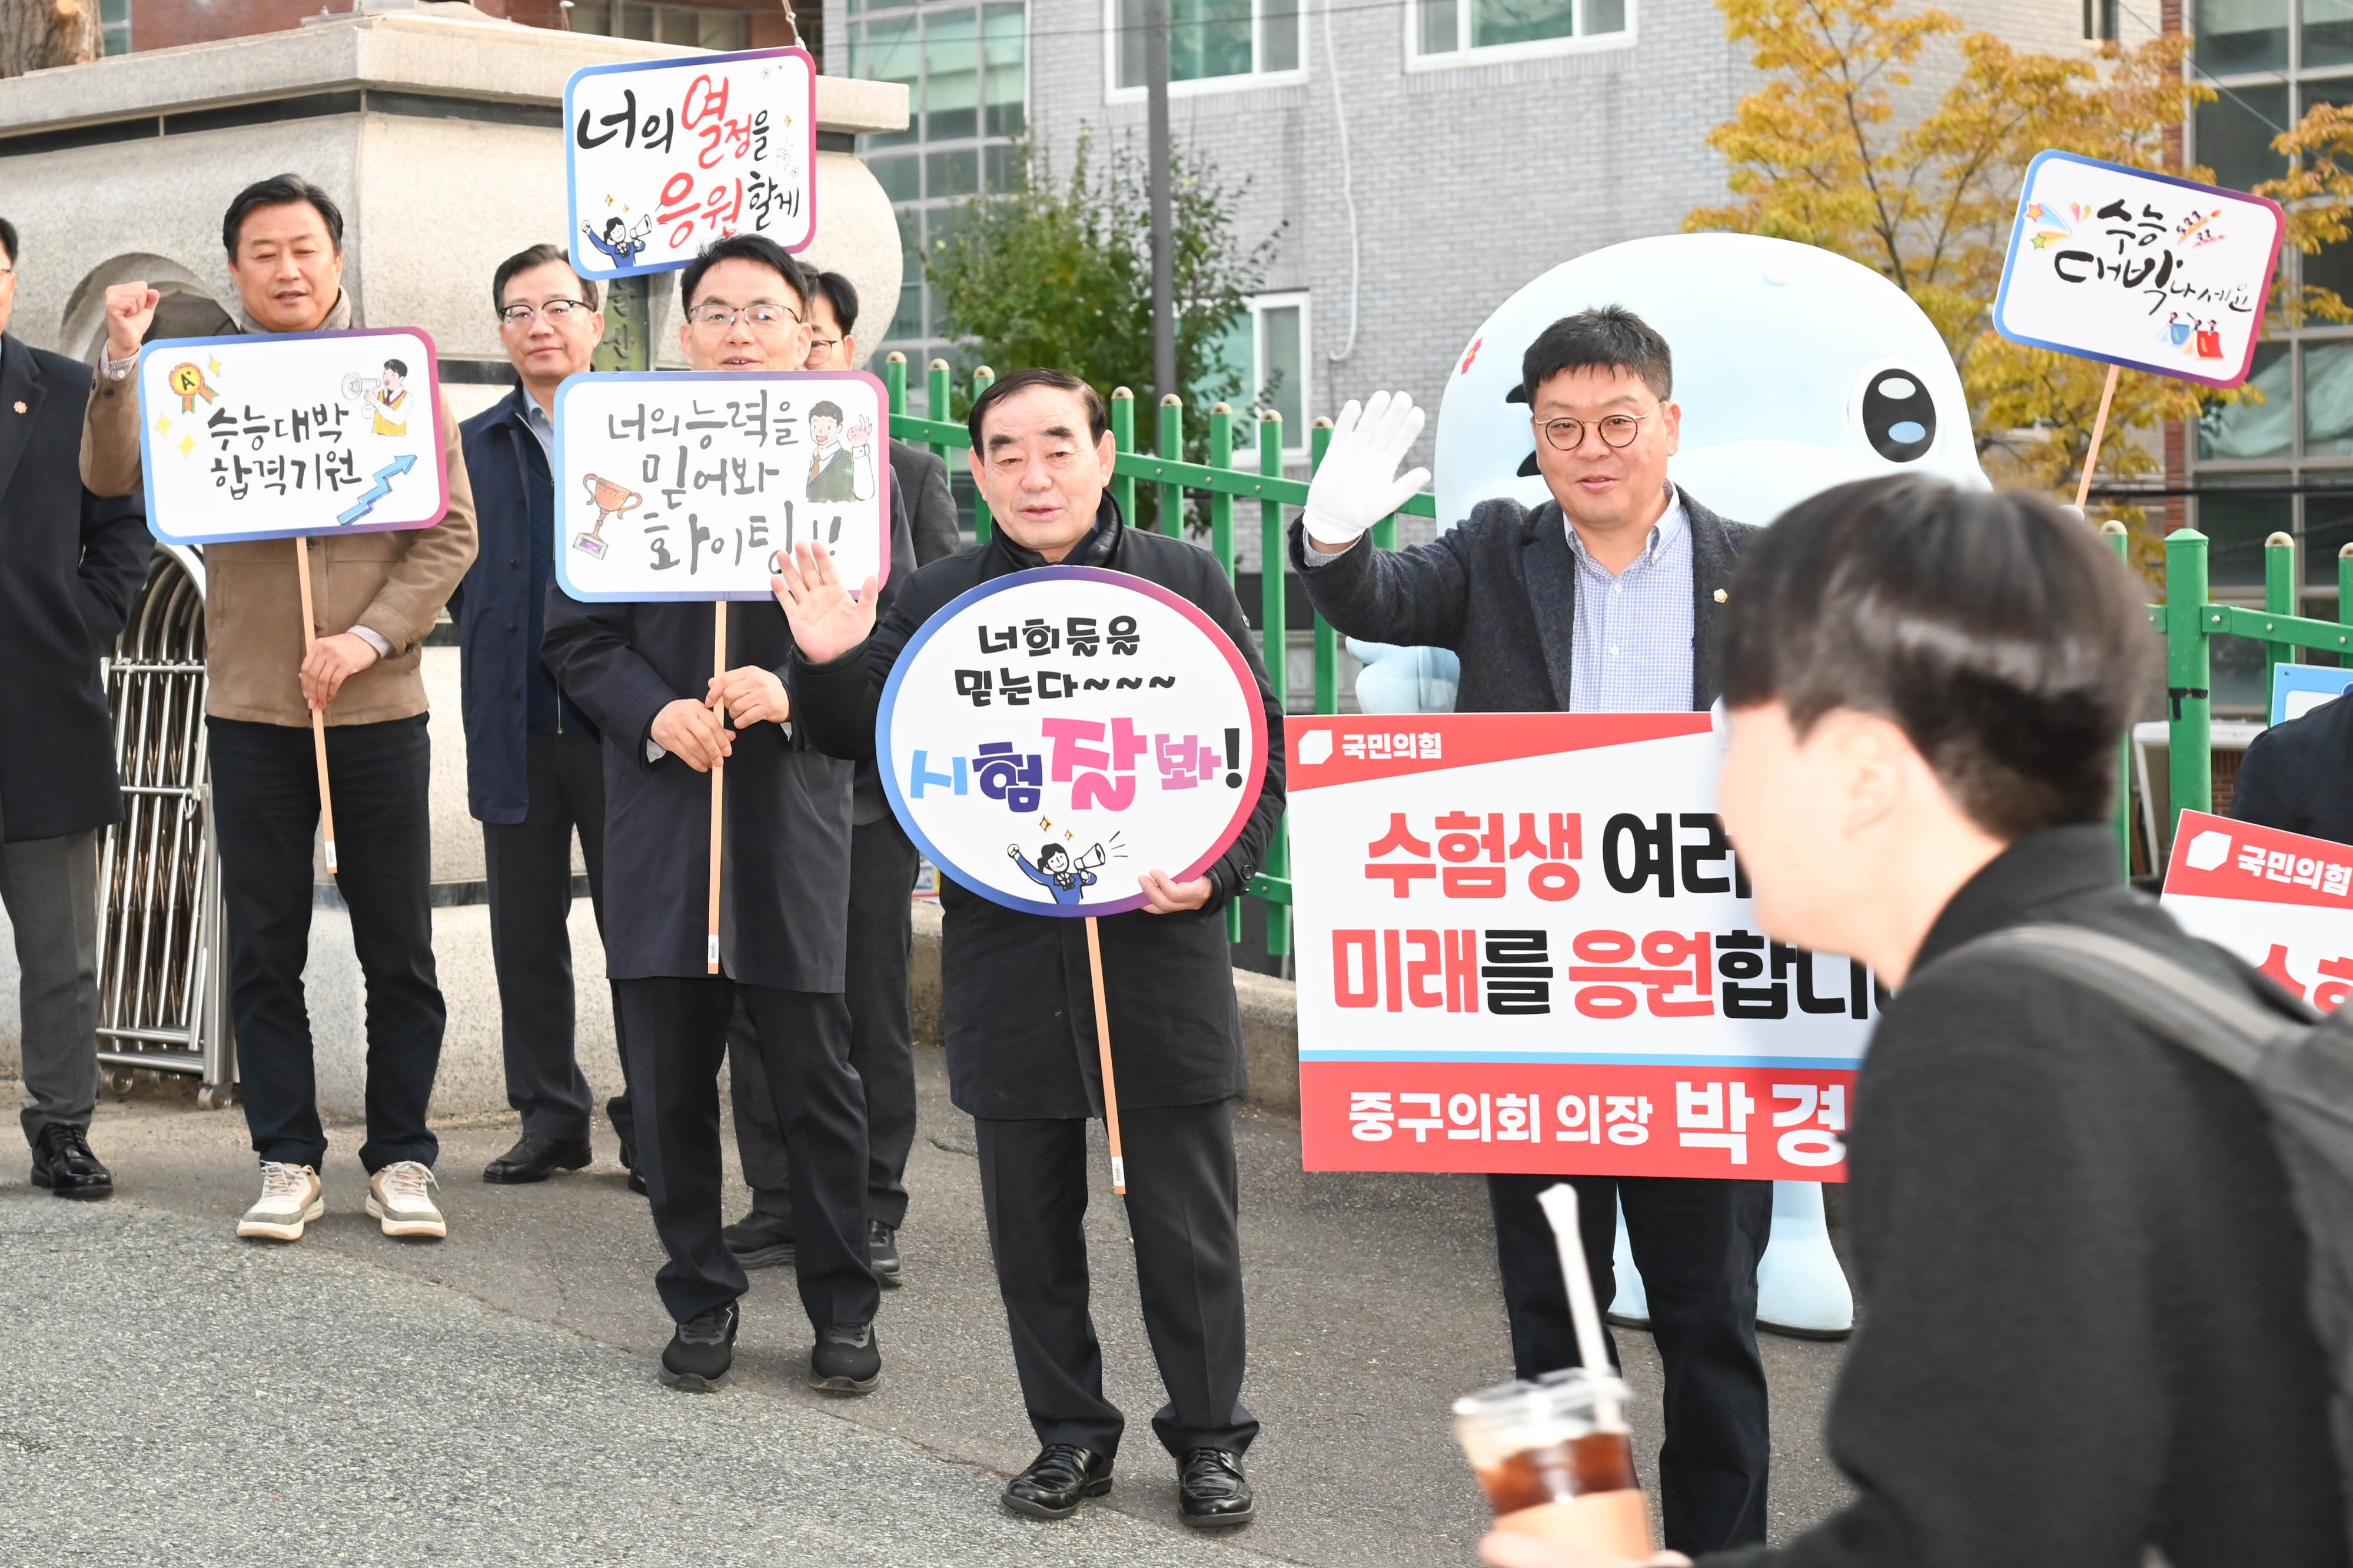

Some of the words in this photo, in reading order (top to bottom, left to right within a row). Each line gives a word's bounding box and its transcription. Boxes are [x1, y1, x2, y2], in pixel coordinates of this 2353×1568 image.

[577, 89, 674, 154] 너의
[681, 74, 770, 169] 열정을
[2097, 198, 2168, 255] 수능
[207, 402, 349, 451] 수능대박
[210, 448, 363, 500] 합격기원
[642, 445, 780, 510] 믿어봐
[978, 615, 1140, 657] 너희들을
[1341, 732, 1442, 760] 국민의힘
[1364, 811, 1583, 902] 수험생
[2238, 844, 2353, 897] 국민의힘
[1332, 929, 1554, 1016] 미래를
[1568, 928, 1896, 1021] 응원합니
[1349, 1092, 1541, 1143] 중구의회
[1556, 1095, 1653, 1146] 의장
